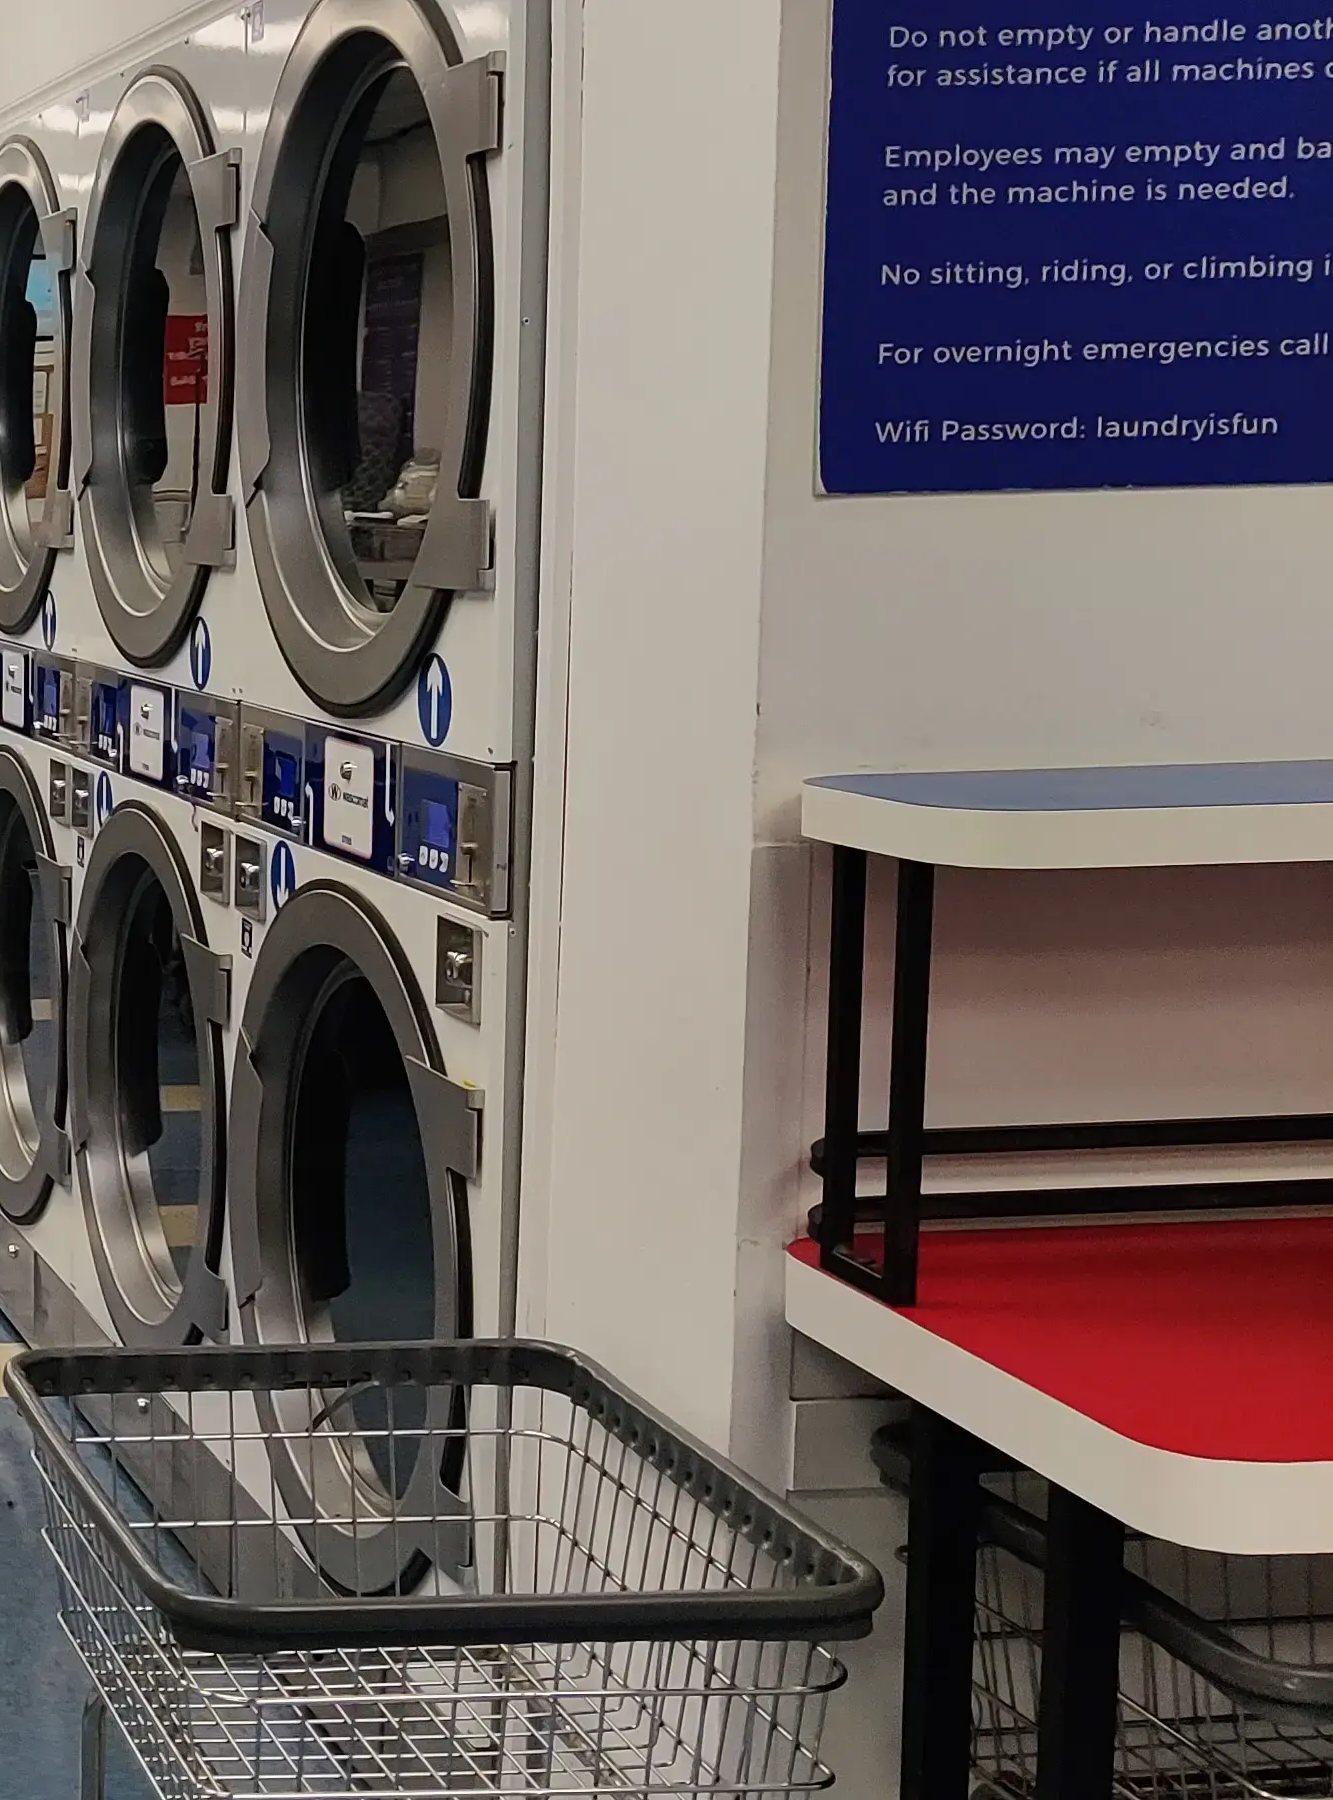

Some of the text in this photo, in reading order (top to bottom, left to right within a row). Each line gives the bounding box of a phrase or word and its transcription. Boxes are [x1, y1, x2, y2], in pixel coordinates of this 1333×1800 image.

[889, 26, 928, 48] Do
[939, 25, 987, 47] not
[997, 24, 1094, 52] empty
[1103, 25, 1134, 44] or
[1144, 18, 1247, 43] handle
[887, 64, 927, 87] for
[936, 62, 1087, 86] assistance
[1098, 60, 1117, 83] if
[1126, 58, 1161, 83] all
[1172, 56, 1315, 82] machines
[885, 143, 1043, 172] Employees
[1054, 145, 1116, 169] may
[1124, 140, 1221, 168] empty
[1230, 137, 1286, 161] and
[883, 176, 1295, 206] and the machine is needed.
[881, 264, 921, 286] No
[930, 261, 1030, 288] sitting,
[1041, 258, 1133, 287] riding,
[1144, 262, 1174, 280] or
[1183, 254, 1314, 283] climbing
[878, 332, 1329, 368] For overnight emergencies call
[875, 412, 1279, 443] Wifi Password: laundryisfun
